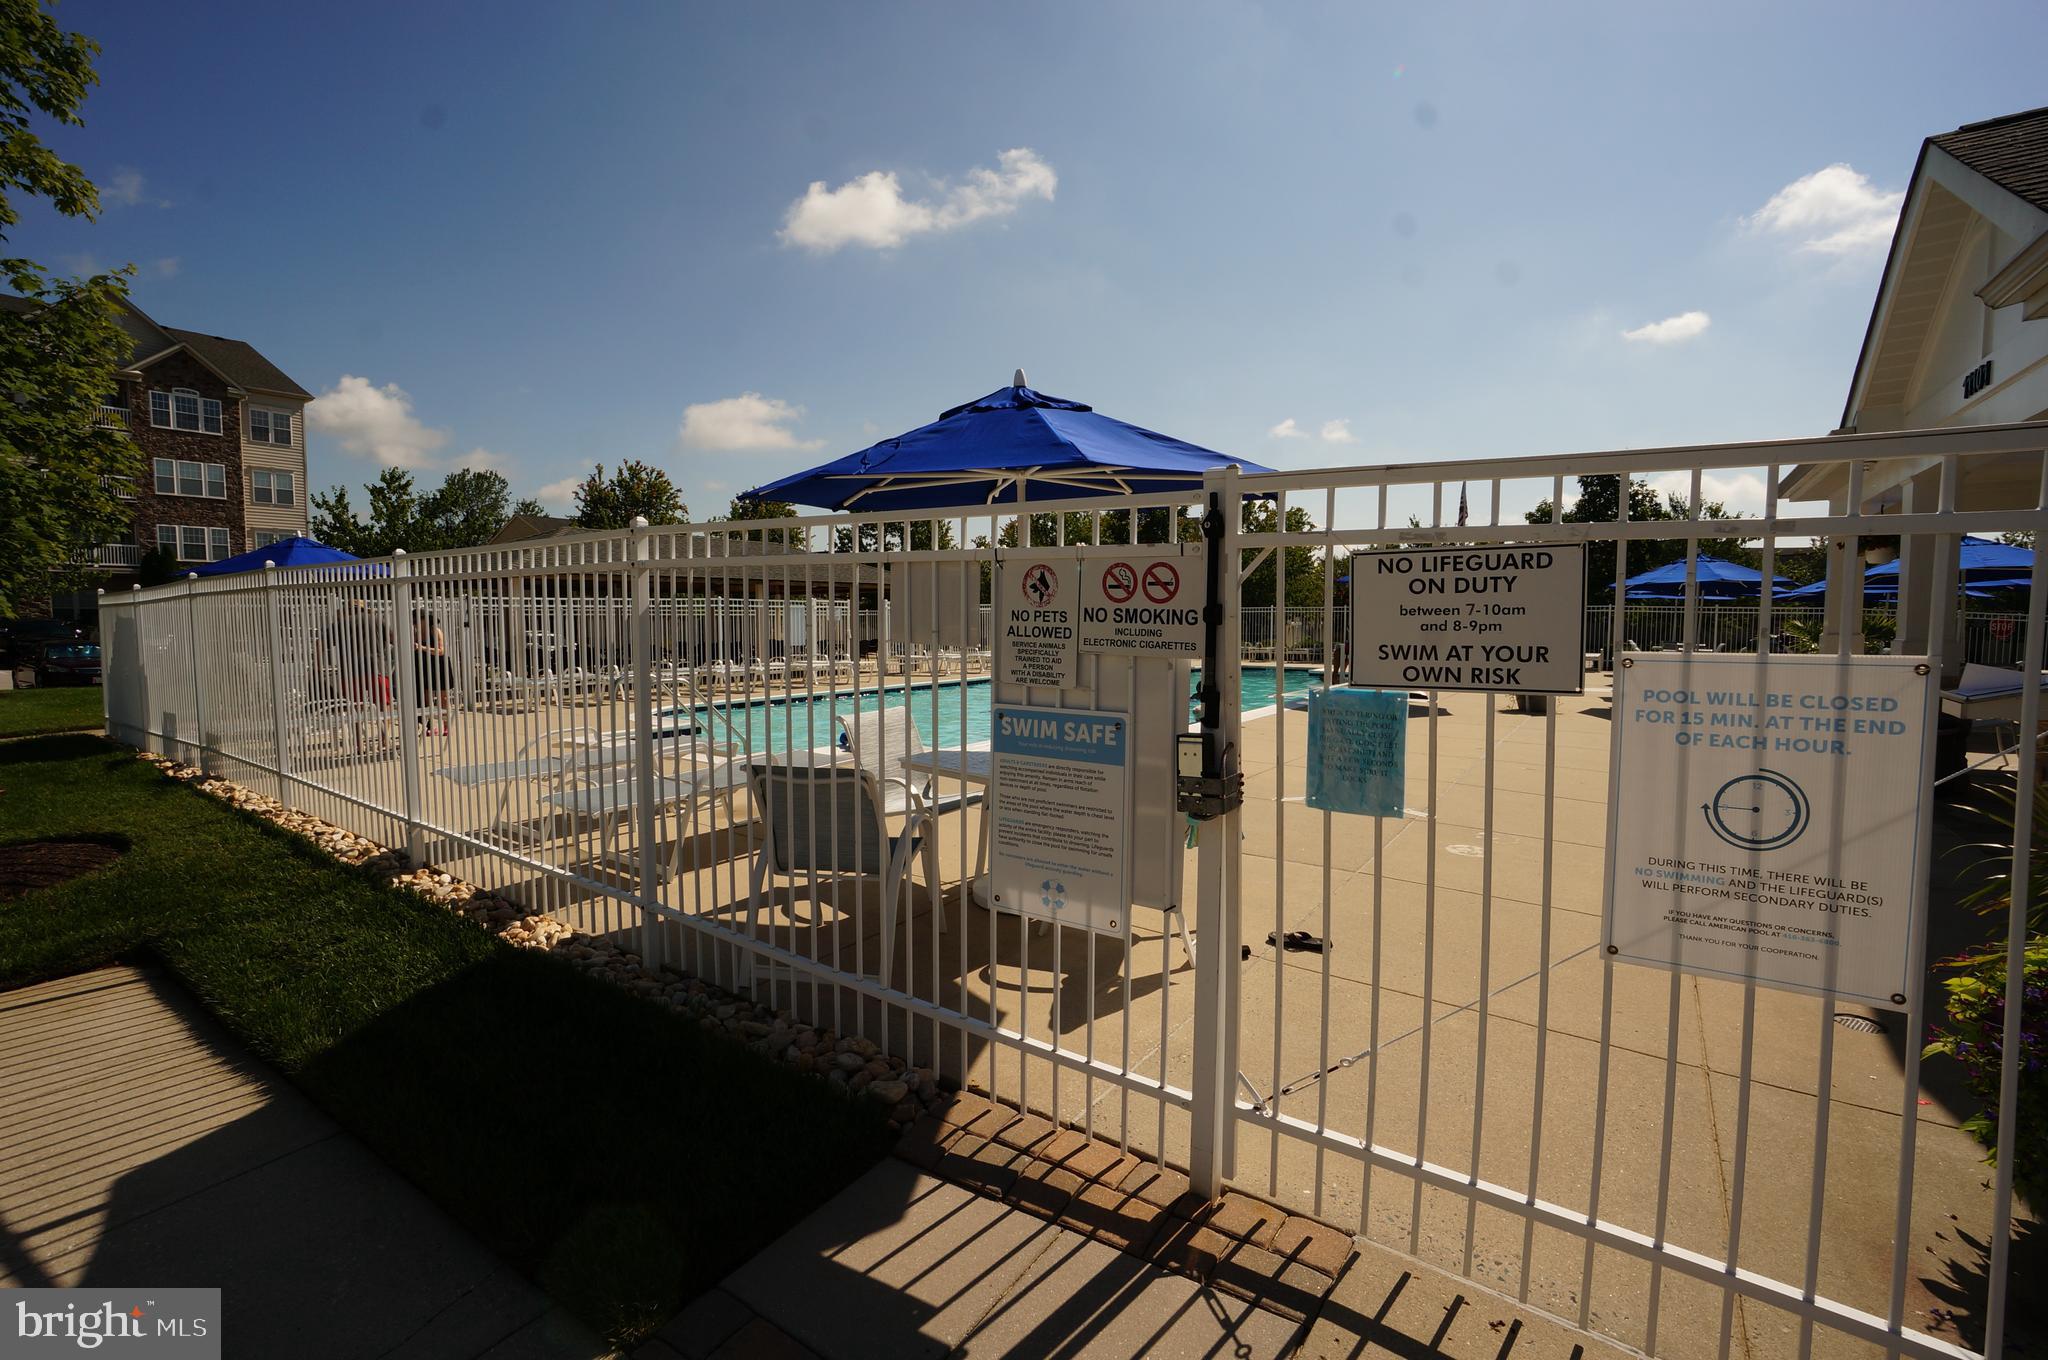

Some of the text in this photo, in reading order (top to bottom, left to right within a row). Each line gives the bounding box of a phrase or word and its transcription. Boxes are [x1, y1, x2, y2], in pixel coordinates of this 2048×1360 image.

[1378, 552, 1553, 573] NO LIFEGUARD
[1409, 575, 1517, 594] ON DUTY
[1011, 609, 1067, 623] NO PETS
[1083, 607, 1198, 625] NO SMOKING
[1400, 604, 1525, 616] between 7-10am
[1006, 625, 1072, 639] ALLOWED
[1115, 627, 1162, 637] INCLUDING
[1420, 620, 1502, 634] and 8-9pm
[1991, 622, 2012, 630] STOP
[1012, 641, 1066, 650] SERVICE ANIMALS
[1017, 648, 1060, 656] SPECIFICALLY
[1083, 638, 1197, 651] ELECTRONIC CIGARETTES
[1378, 644, 1548, 662] SWIM AT YOUR
[1015, 655, 1062, 665] TRAINED TO AID
[1011, 669, 1065, 678] WITH A DISABILITY
[1015, 677, 1060, 686] ARE WELCOME
[1403, 665, 1520, 684] OWN RISK
[1644, 689, 1898, 711] POOL WILL BE CLOSED
[1635, 709, 1906, 735] FOR 15 MIN. AT THE END
[1001, 717, 1117, 746] SWIM SAFE
[1675, 732, 1851, 754] OF EACH HOUR.
[1648, 857, 1695, 870] DURING
[1699, 862, 1726, 873] THIS
[1767, 871, 1809, 884] THERE
[1813, 876, 1846, 888] WILL
[1851, 880, 1868, 891] BE
[1657, 870, 1724, 885] SWIMMING
[1728, 879, 1756, 889] AND
[1759, 882, 1785, 893] THE
[1789, 886, 1883, 906] LIFEGUARD(S)
[1642, 879, 1871, 917] WILL PERFORM SECONDARY DUTIES.
[1663, 915, 1688, 924] PLEASE
[1689, 920, 1707, 928] CALL
[1708, 923, 1747, 934] AMERICAN
[1748, 928, 1770, 936] POOL
[1692, 912, 1711, 920] HAVE
[1729, 918, 1772, 929] QUESTIONS
[1679, 933, 1703, 942] THANK
[1760, 946, 1819, 960] COOPERATION.
